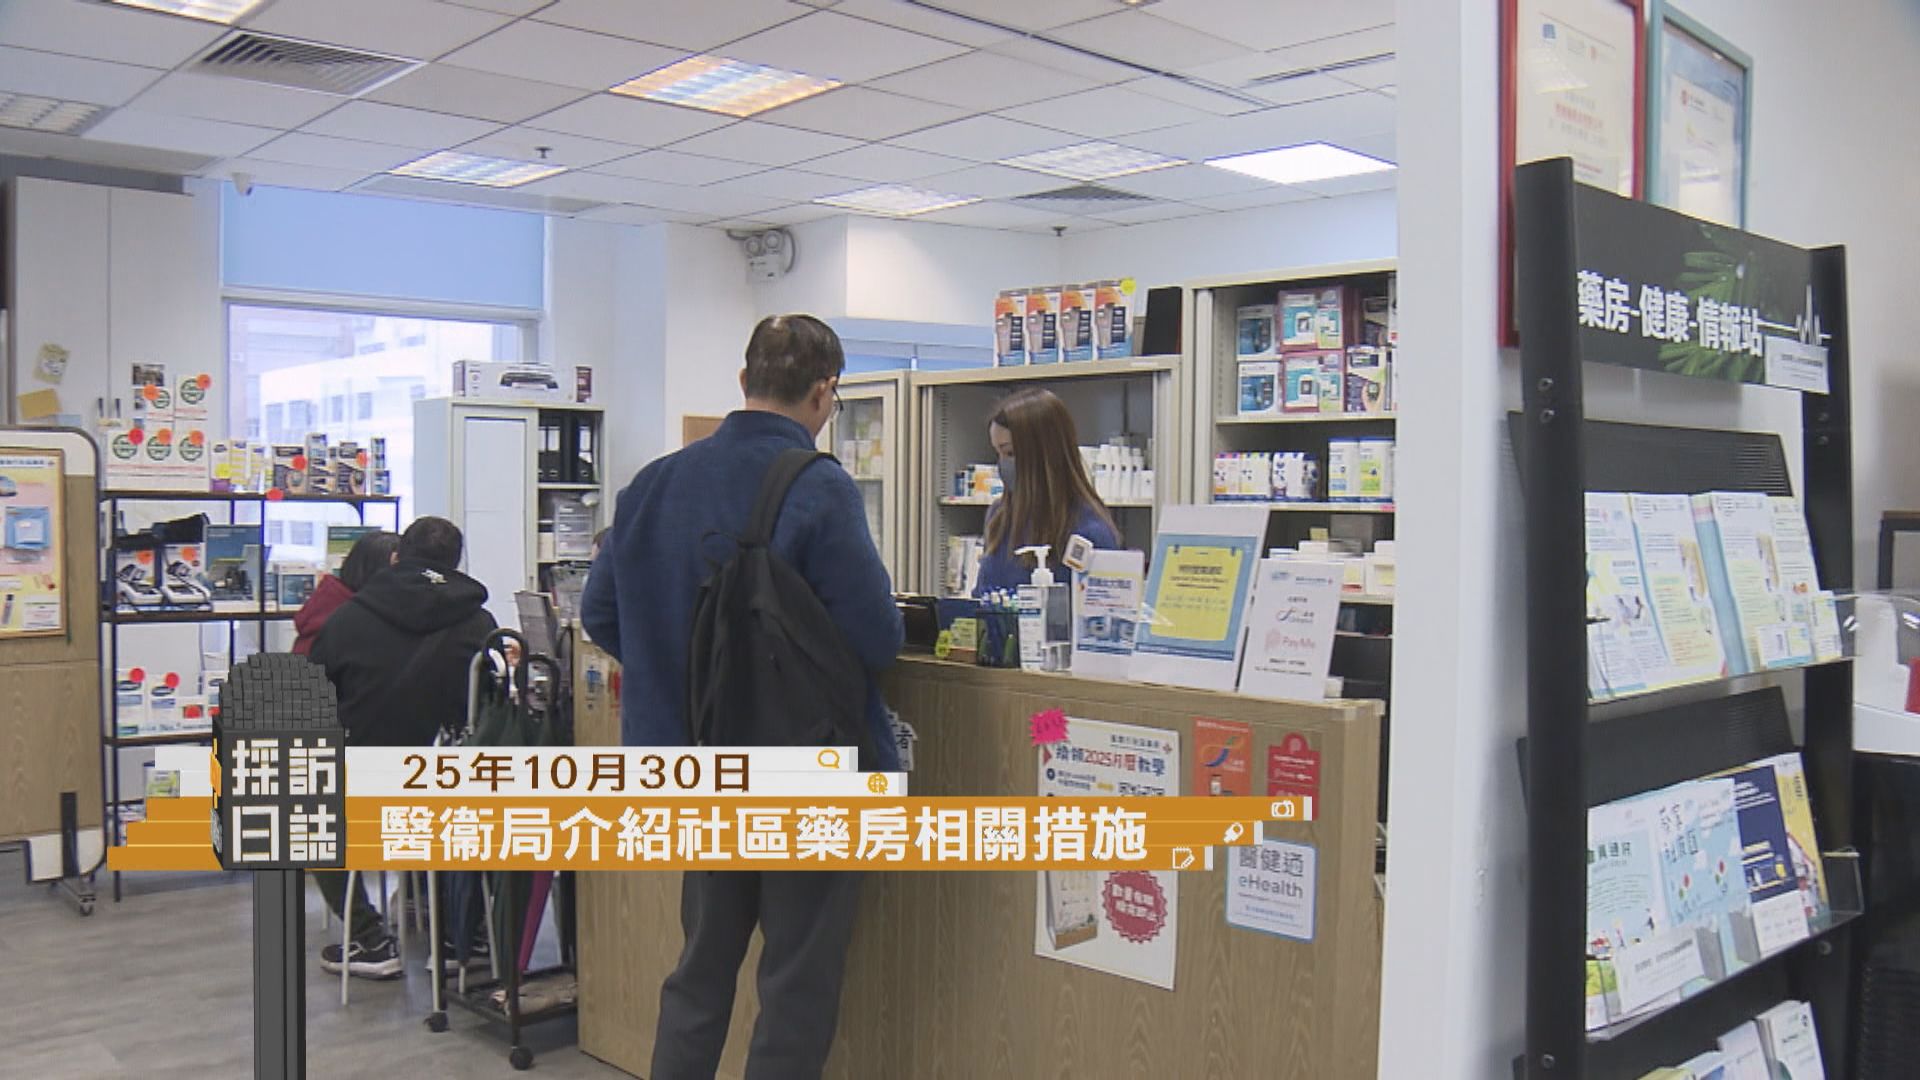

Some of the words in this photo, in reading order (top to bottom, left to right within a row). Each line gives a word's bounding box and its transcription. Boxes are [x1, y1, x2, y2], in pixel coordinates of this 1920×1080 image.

[1576, 269, 1763, 357] 藥房-健康-情報站
[1238, 873, 1304, 899] eHealth
